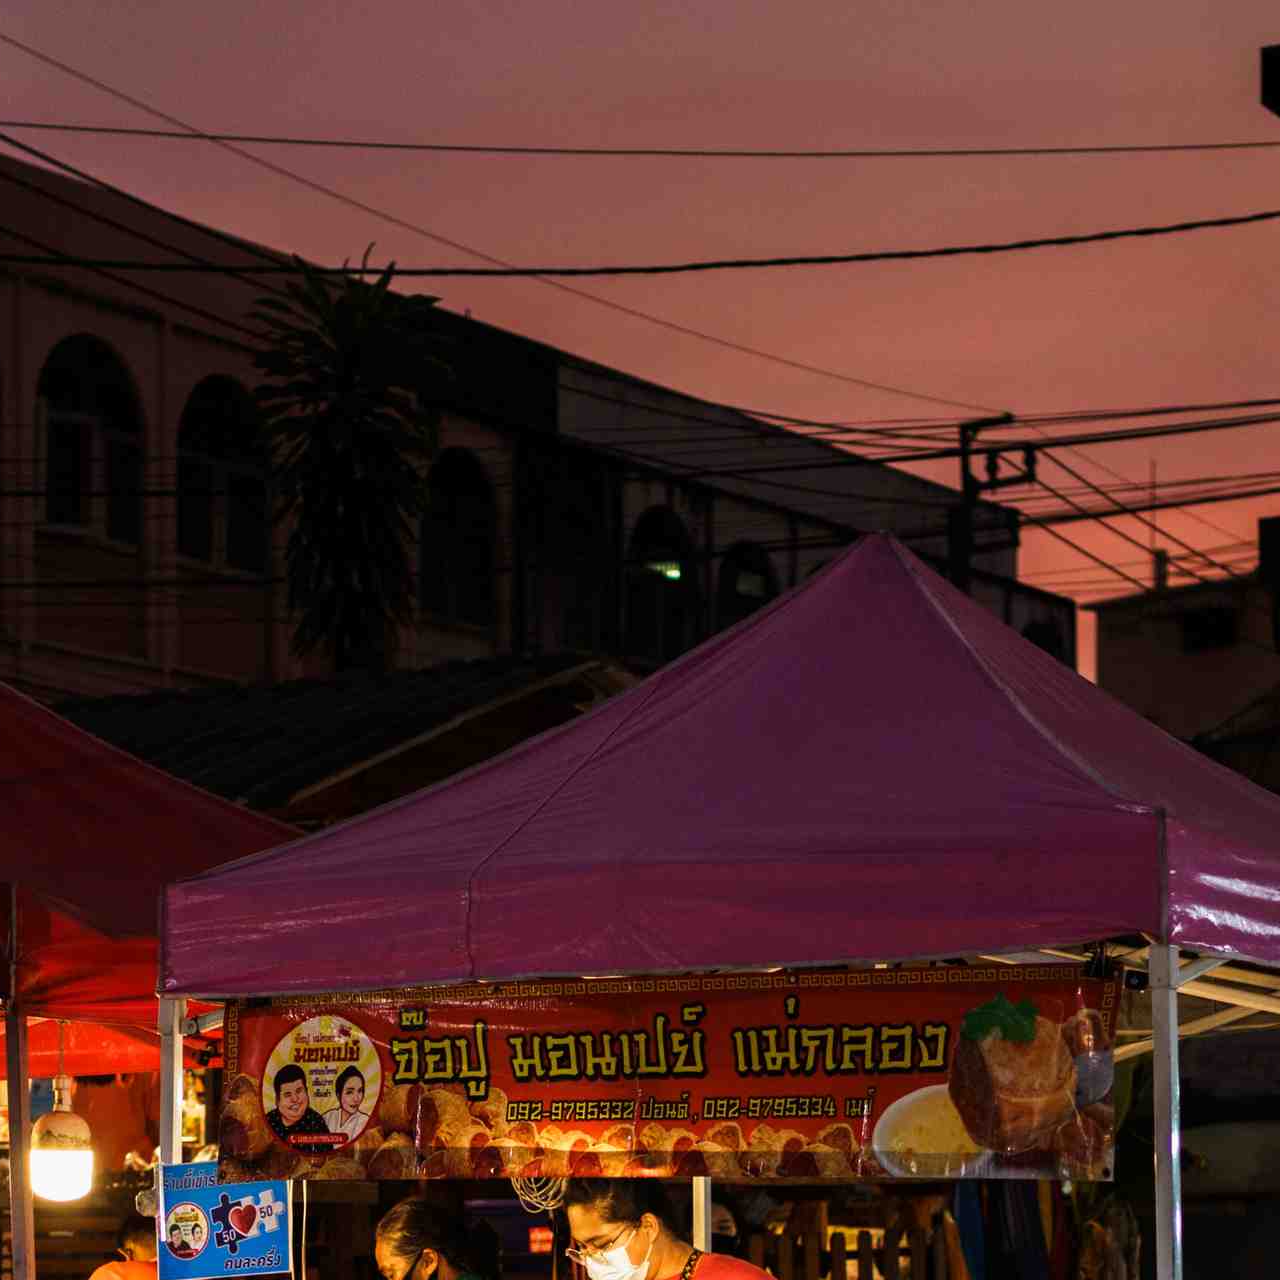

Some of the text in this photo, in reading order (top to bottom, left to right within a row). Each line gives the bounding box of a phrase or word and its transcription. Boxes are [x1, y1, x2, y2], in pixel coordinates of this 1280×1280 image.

[392, 1009, 488, 1097] จ๊อปู
[510, 1005, 705, 1081] มอนเปย์
[733, 996, 948, 1075] แม่กลอง
[507, 1100, 633, 1121] 092-9795332
[703, 1097, 835, 1120] 092-9795334
[259, 1204, 273, 1219] 50
[221, 1228, 237, 1243] 50
[224, 1246, 281, 1270] คนละครึ่ง
